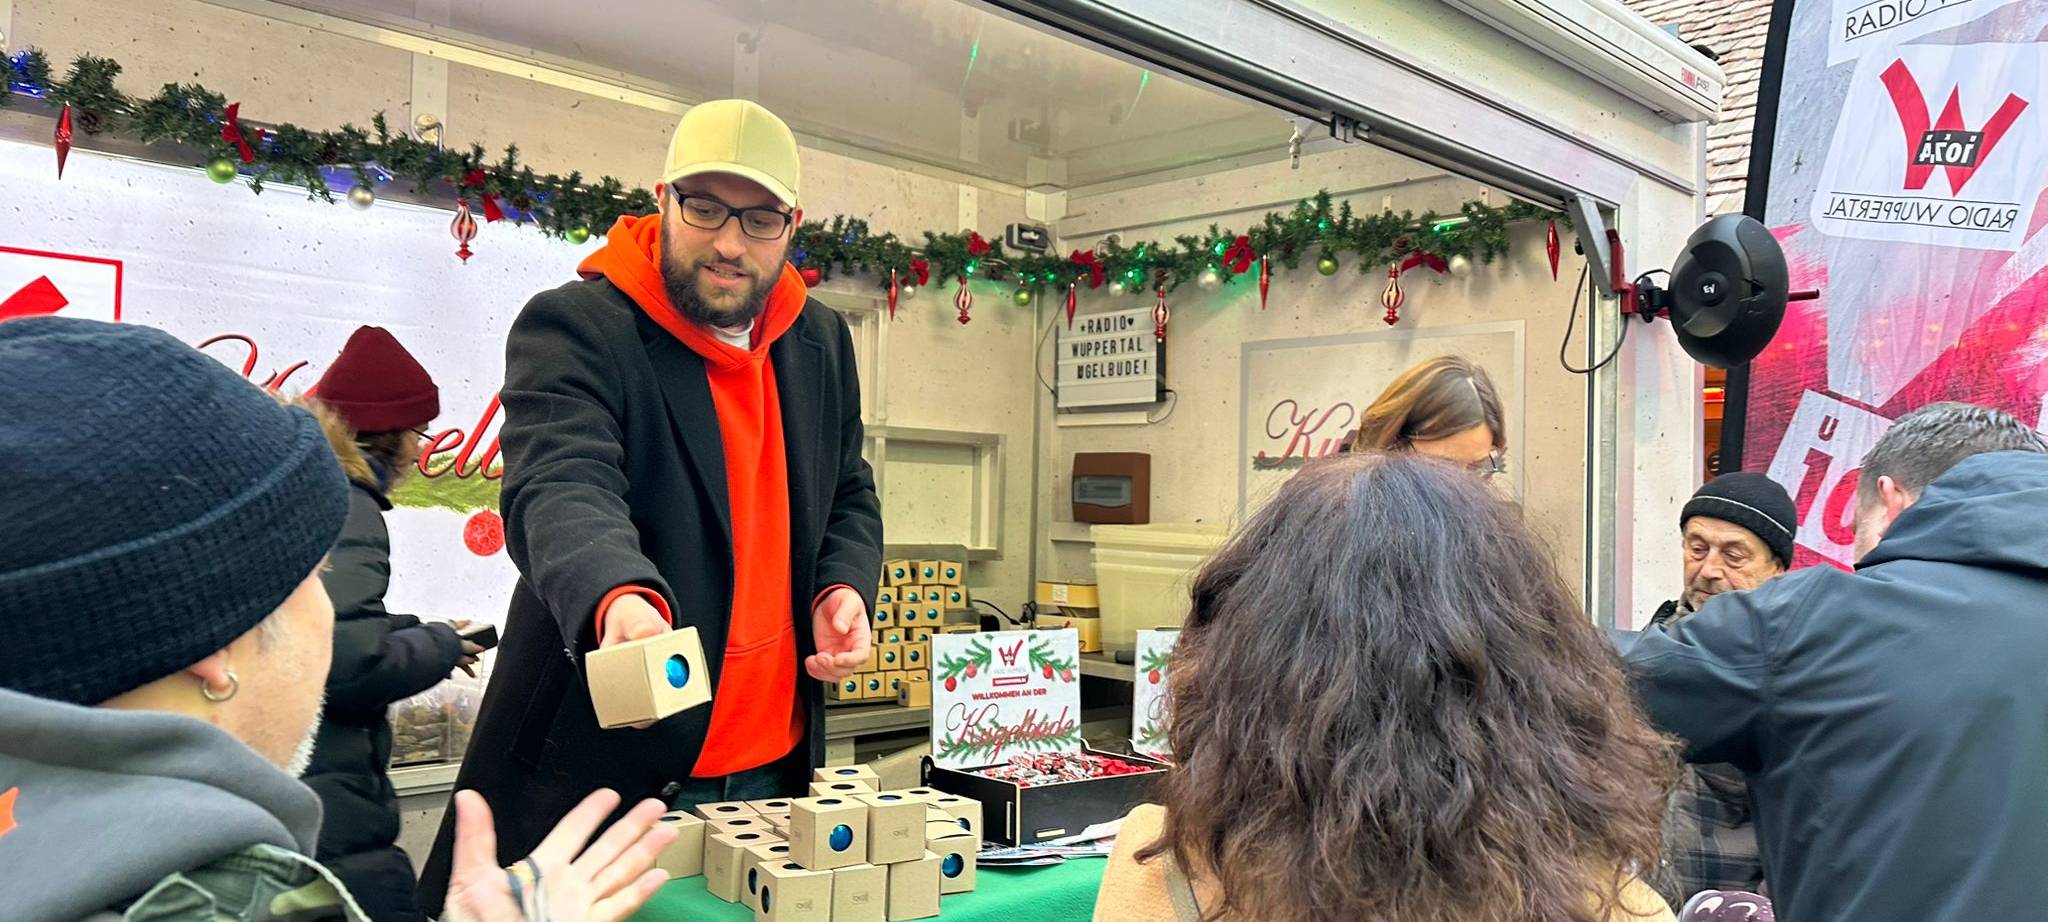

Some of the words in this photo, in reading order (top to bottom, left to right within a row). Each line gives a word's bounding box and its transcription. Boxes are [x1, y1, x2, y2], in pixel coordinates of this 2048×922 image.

[1845, 0, 1926, 38] RADIO
[1088, 315, 1126, 334] RADIO
[1072, 337, 1143, 357] WUPPERTAL
[972, 690, 1020, 700] WILLKOMMEN
[1033, 688, 1047, 696] DER
[945, 703, 1074, 763] Kugelbude
